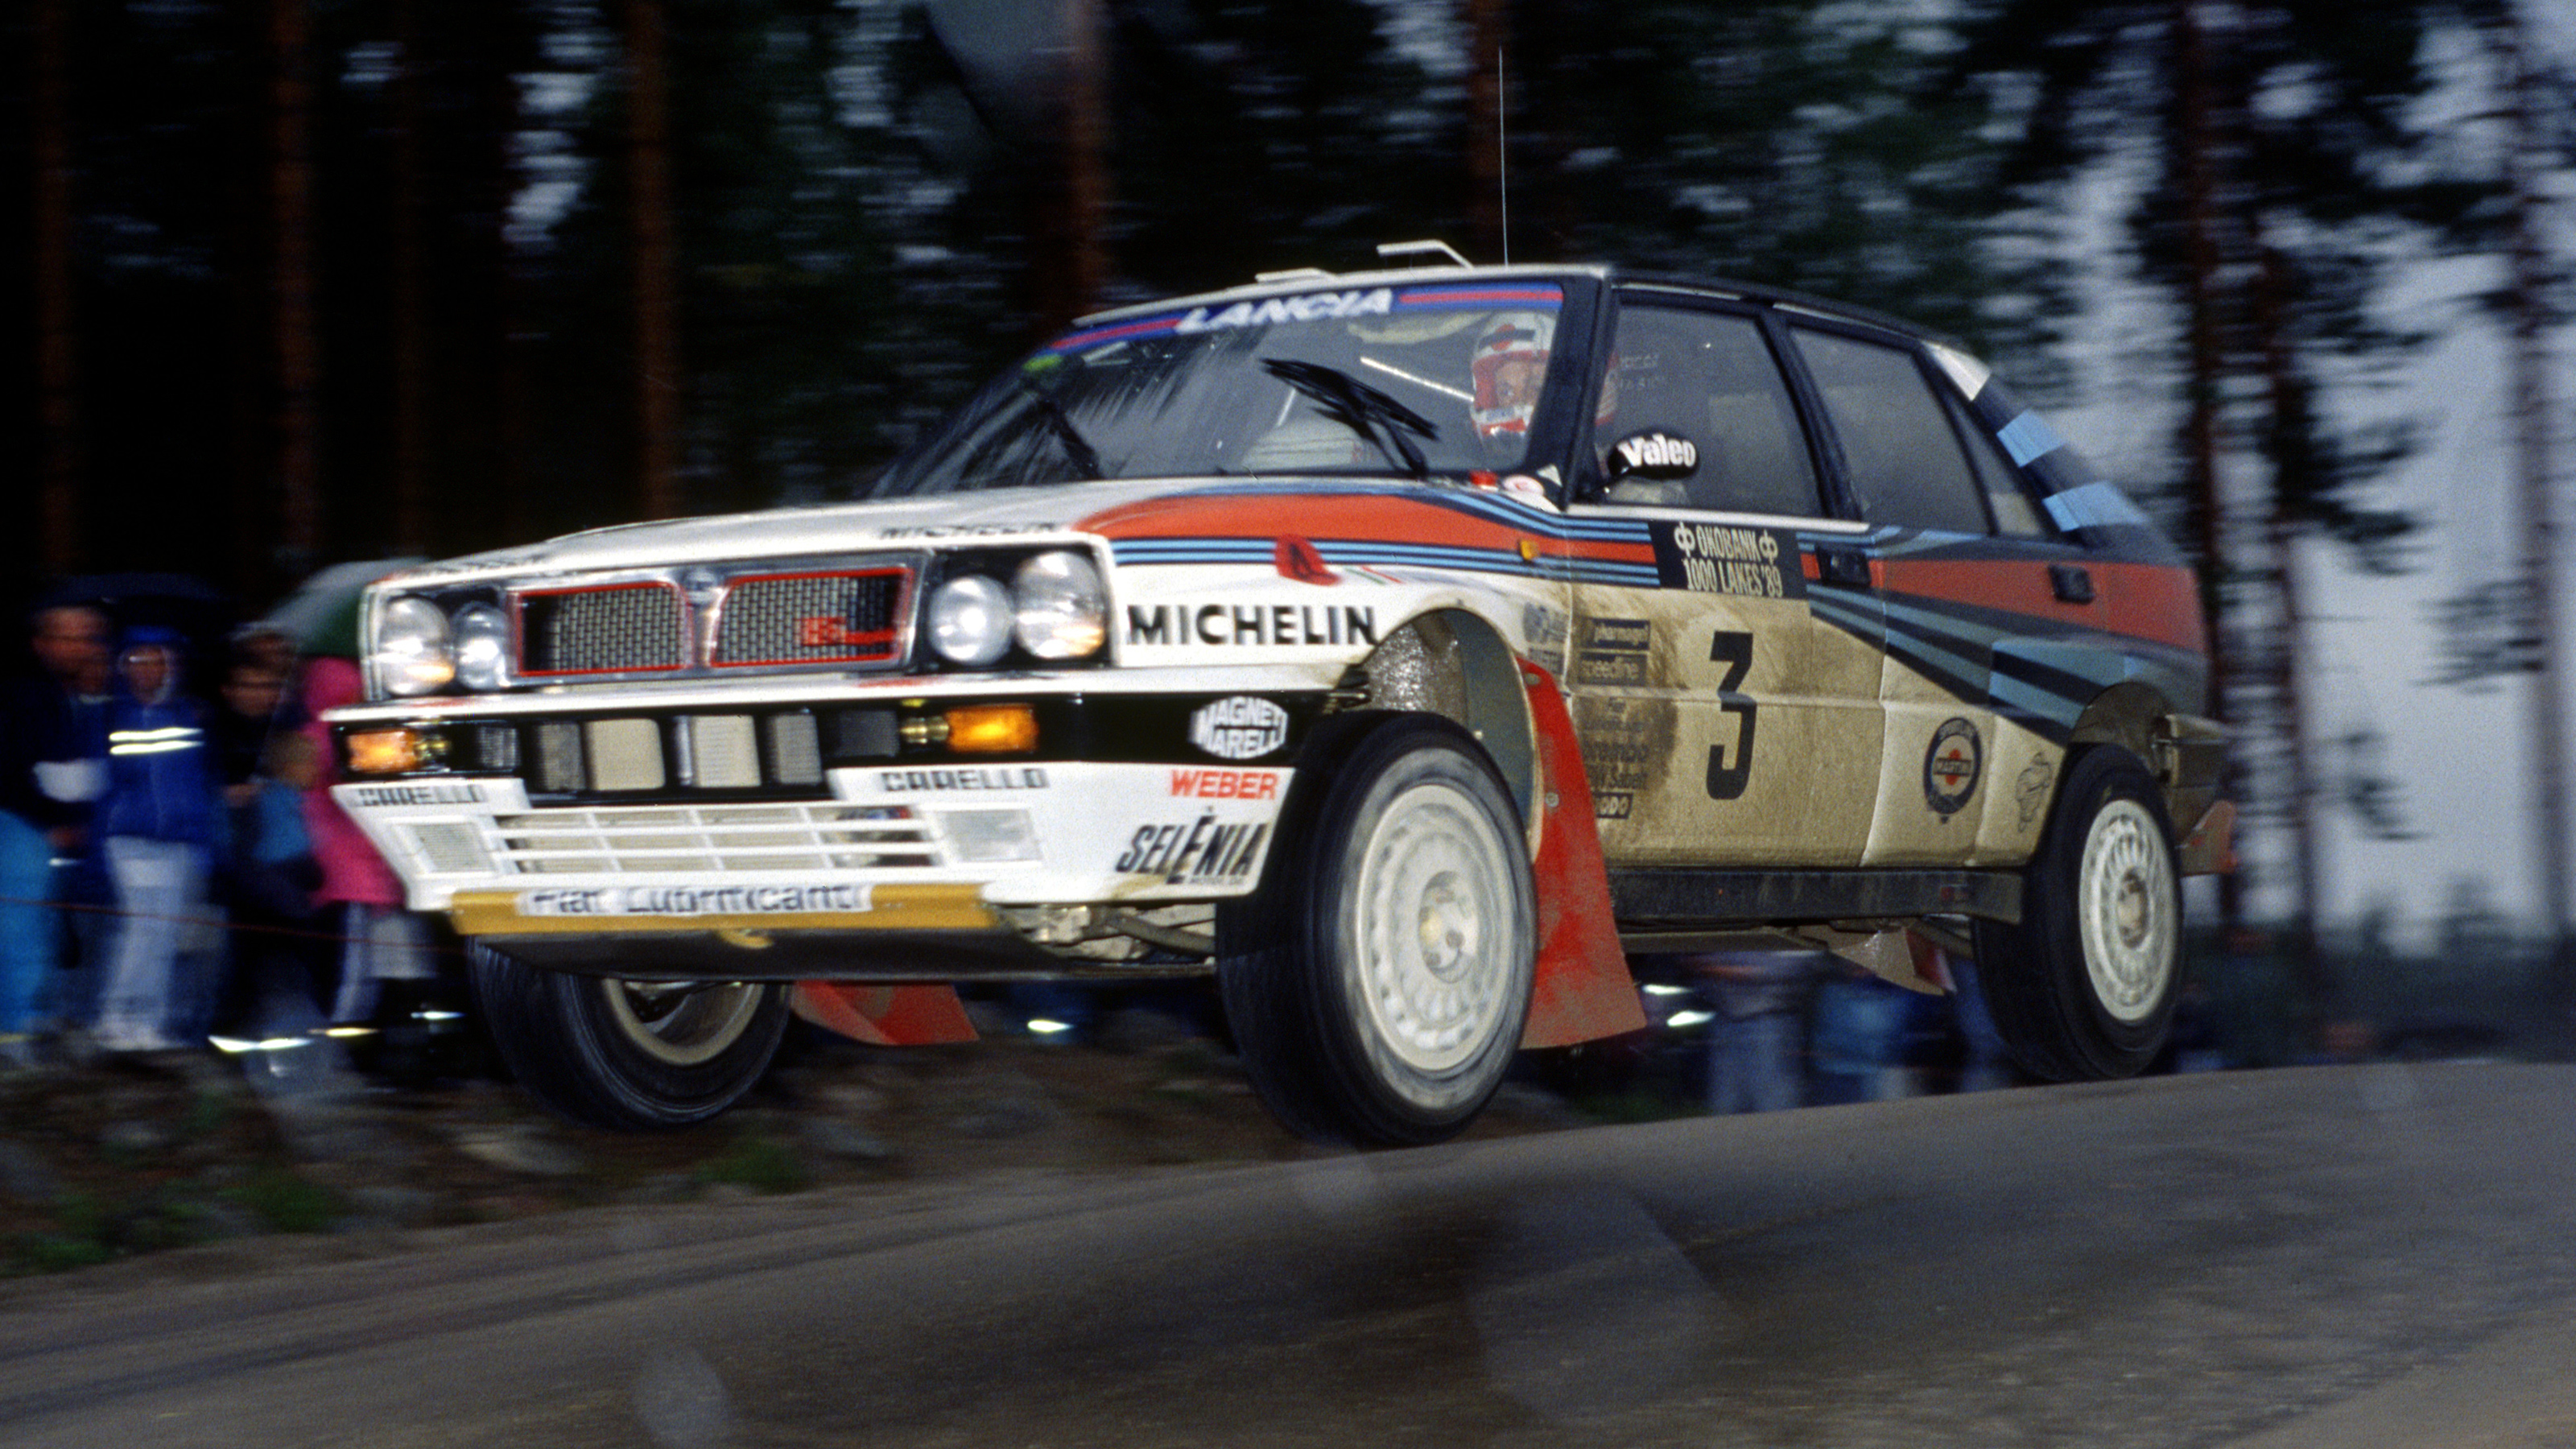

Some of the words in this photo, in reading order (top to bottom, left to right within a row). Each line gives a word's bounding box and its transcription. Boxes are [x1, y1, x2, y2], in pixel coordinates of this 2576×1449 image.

[1174, 287, 1392, 335] LANCIA
[1617, 433, 1696, 468] Valeo
[1682, 558, 1718, 592] 1000
[1719, 560, 1763, 597] LAKES
[1761, 564, 1783, 597] '89
[1127, 603, 1377, 646] MICHELIN
[1191, 696, 1288, 726] MAGNETI
[1706, 630, 1757, 799] 3
[1170, 770, 1279, 800] WEBER
